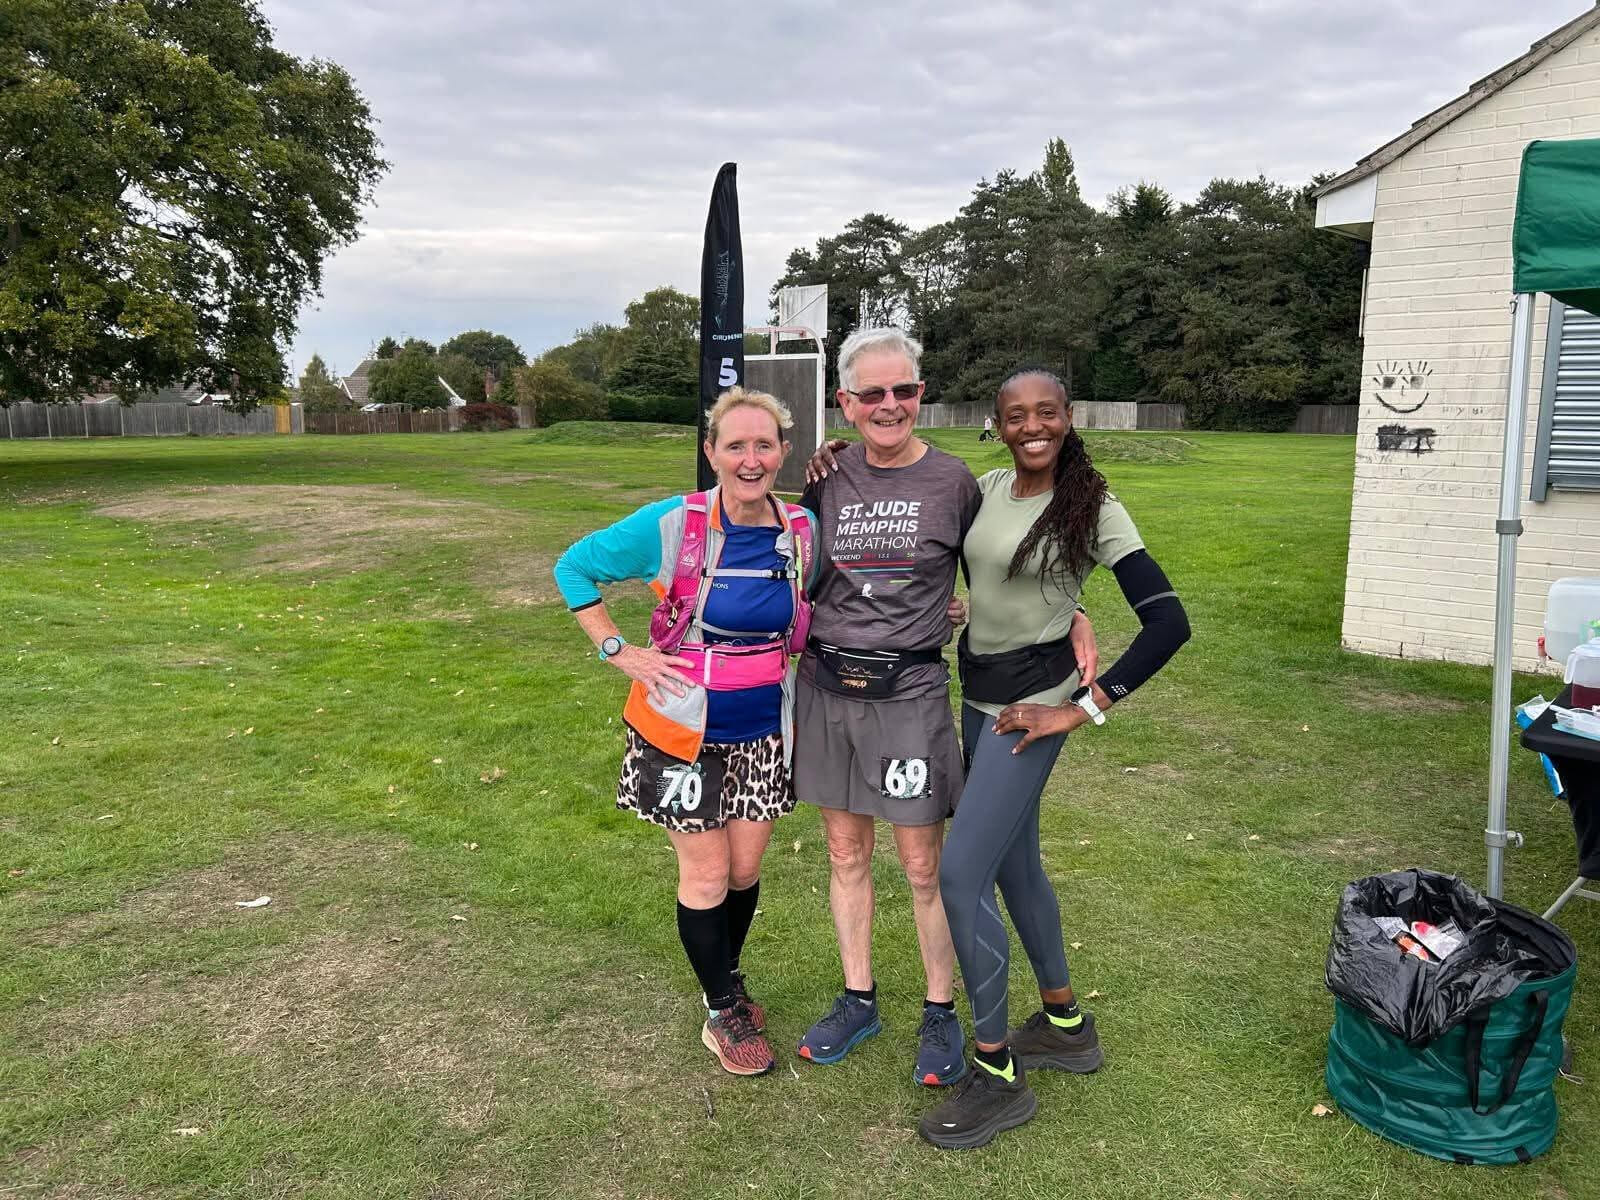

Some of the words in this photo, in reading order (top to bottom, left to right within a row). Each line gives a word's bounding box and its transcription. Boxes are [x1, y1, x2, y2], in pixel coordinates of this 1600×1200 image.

[718, 357, 738, 387] 5
[838, 503, 864, 520] ST.
[865, 501, 921, 518] JUDE
[836, 519, 919, 537] MEMPHIS
[832, 535, 918, 552] MARATHON
[885, 758, 928, 796] 69
[658, 769, 702, 811] 70
